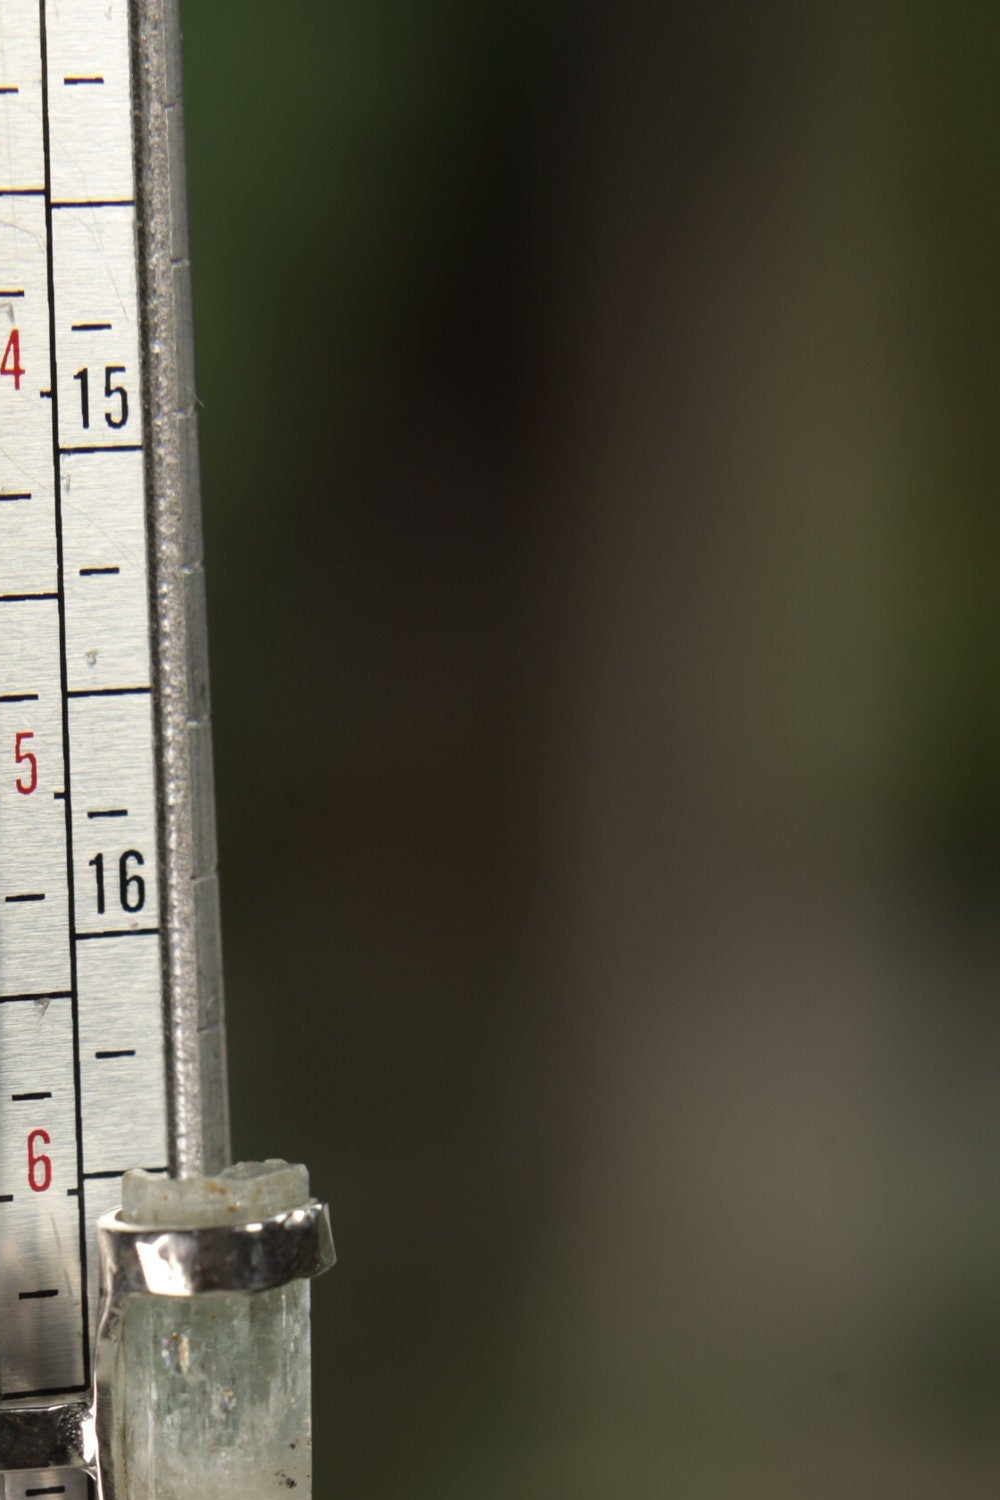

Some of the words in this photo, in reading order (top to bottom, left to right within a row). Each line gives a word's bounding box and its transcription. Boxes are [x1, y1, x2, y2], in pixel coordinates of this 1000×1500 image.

[0, 329, 25, 391] 4
[72, 365, 130, 429] 15
[14, 732, 38, 795] 5
[88, 849, 146, 914] 16
[26, 1129, 53, 1192] 6
